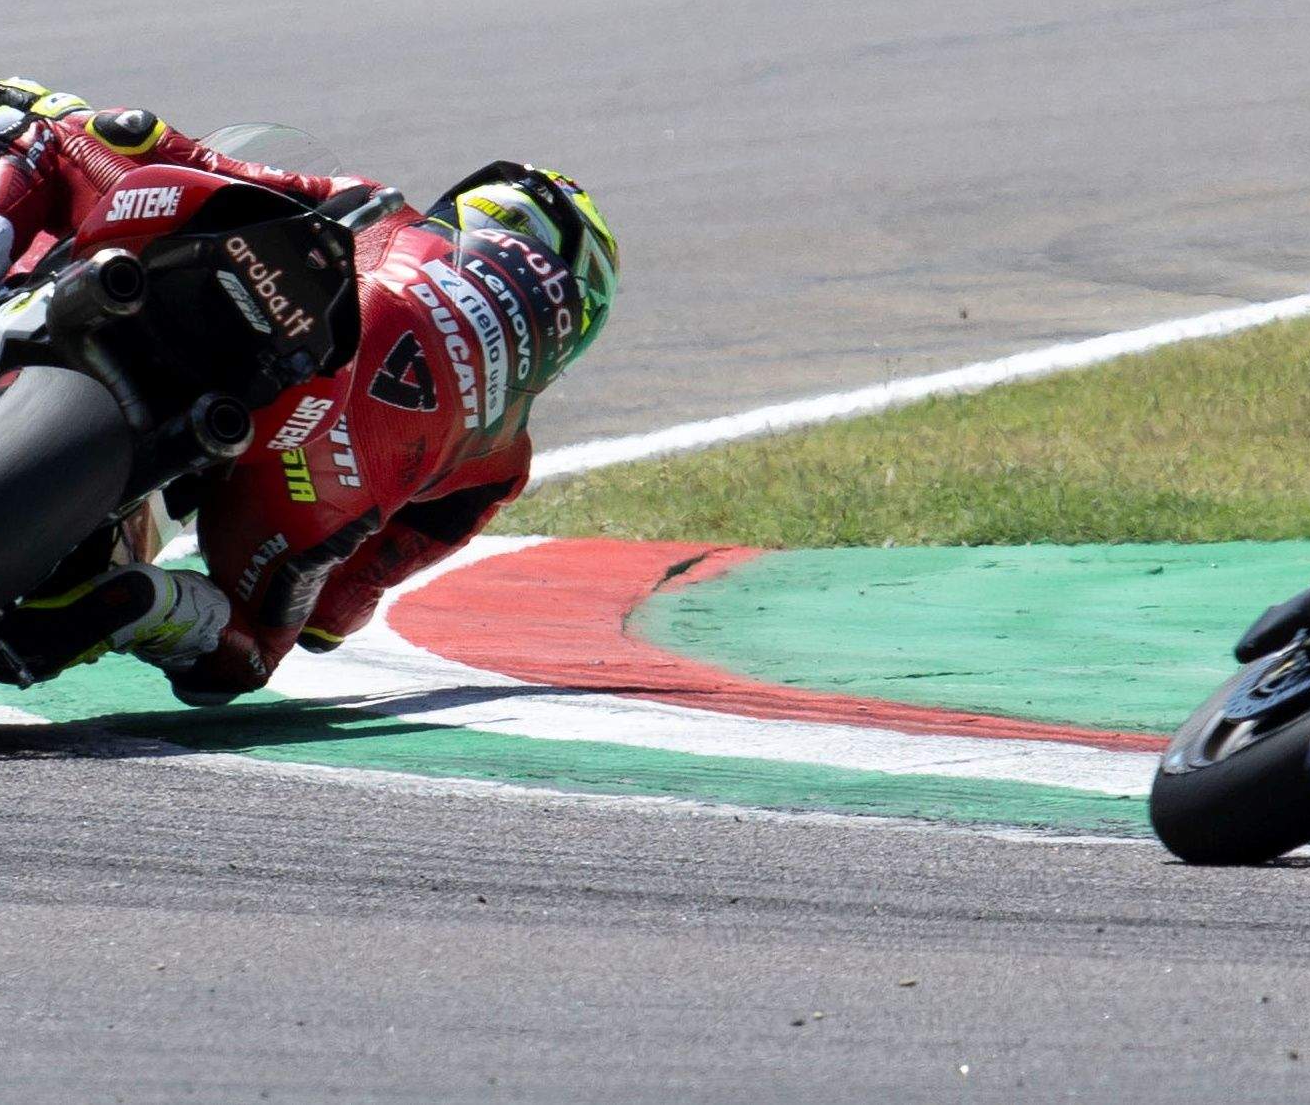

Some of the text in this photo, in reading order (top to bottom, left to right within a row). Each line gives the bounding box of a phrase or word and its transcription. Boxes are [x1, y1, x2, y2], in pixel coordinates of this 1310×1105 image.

[410, 283, 479, 429] DUCATI
[458, 295, 501, 360] riello
[465, 260, 531, 380] Lenovo
